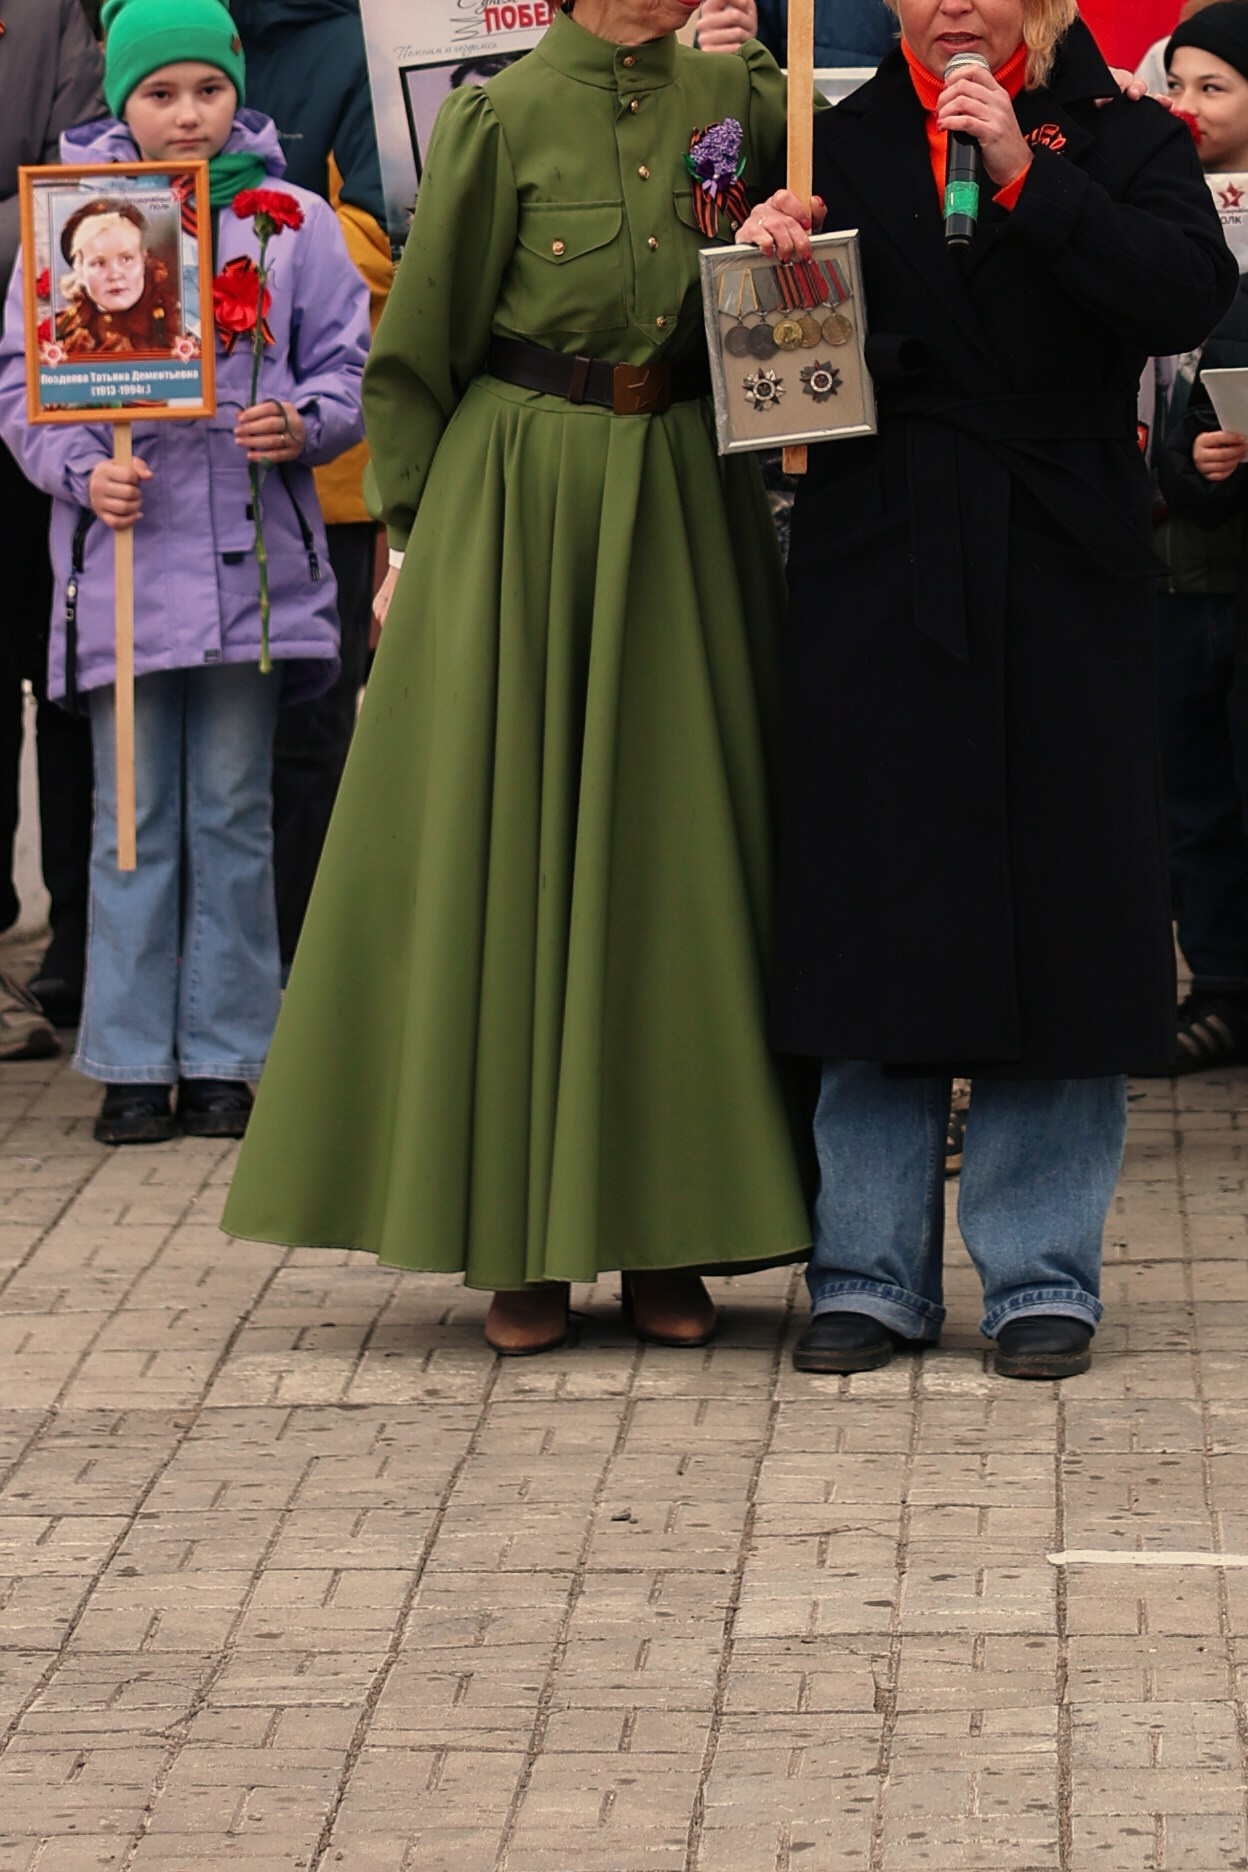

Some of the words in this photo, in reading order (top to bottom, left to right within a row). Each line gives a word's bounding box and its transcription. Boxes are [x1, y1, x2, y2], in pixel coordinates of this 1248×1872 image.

[485, 1, 554, 35] ПОБЕ
[41, 373, 89, 385] Поздеева
[90, 371, 130, 383] Татьяна
[132, 369, 199, 383] Дементьевна
